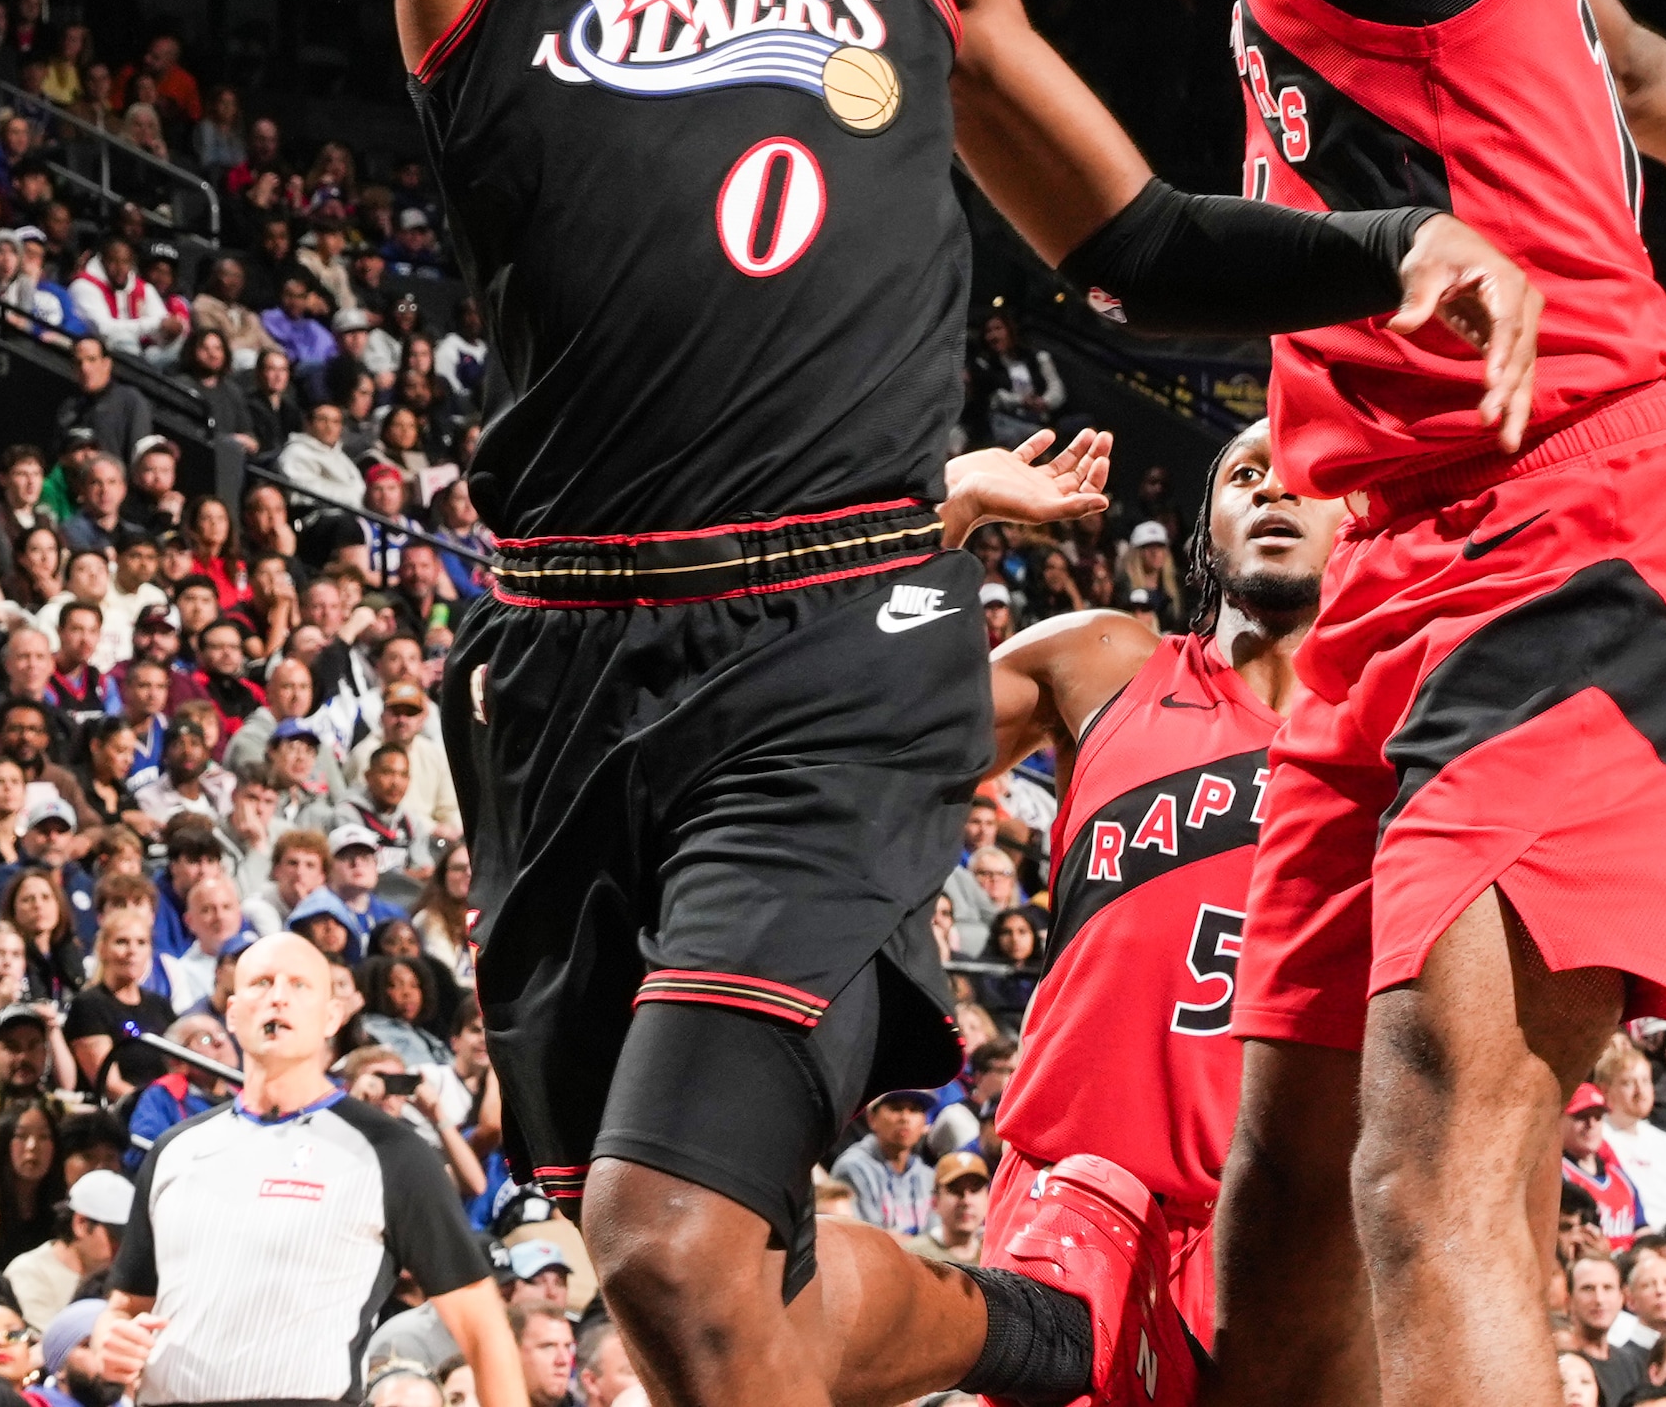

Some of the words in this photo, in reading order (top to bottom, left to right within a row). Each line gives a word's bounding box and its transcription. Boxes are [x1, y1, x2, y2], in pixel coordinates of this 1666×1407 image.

[715, 135, 827, 278] 0
[887, 583, 948, 615] NIKE
[1170, 902, 1248, 1037] 5
